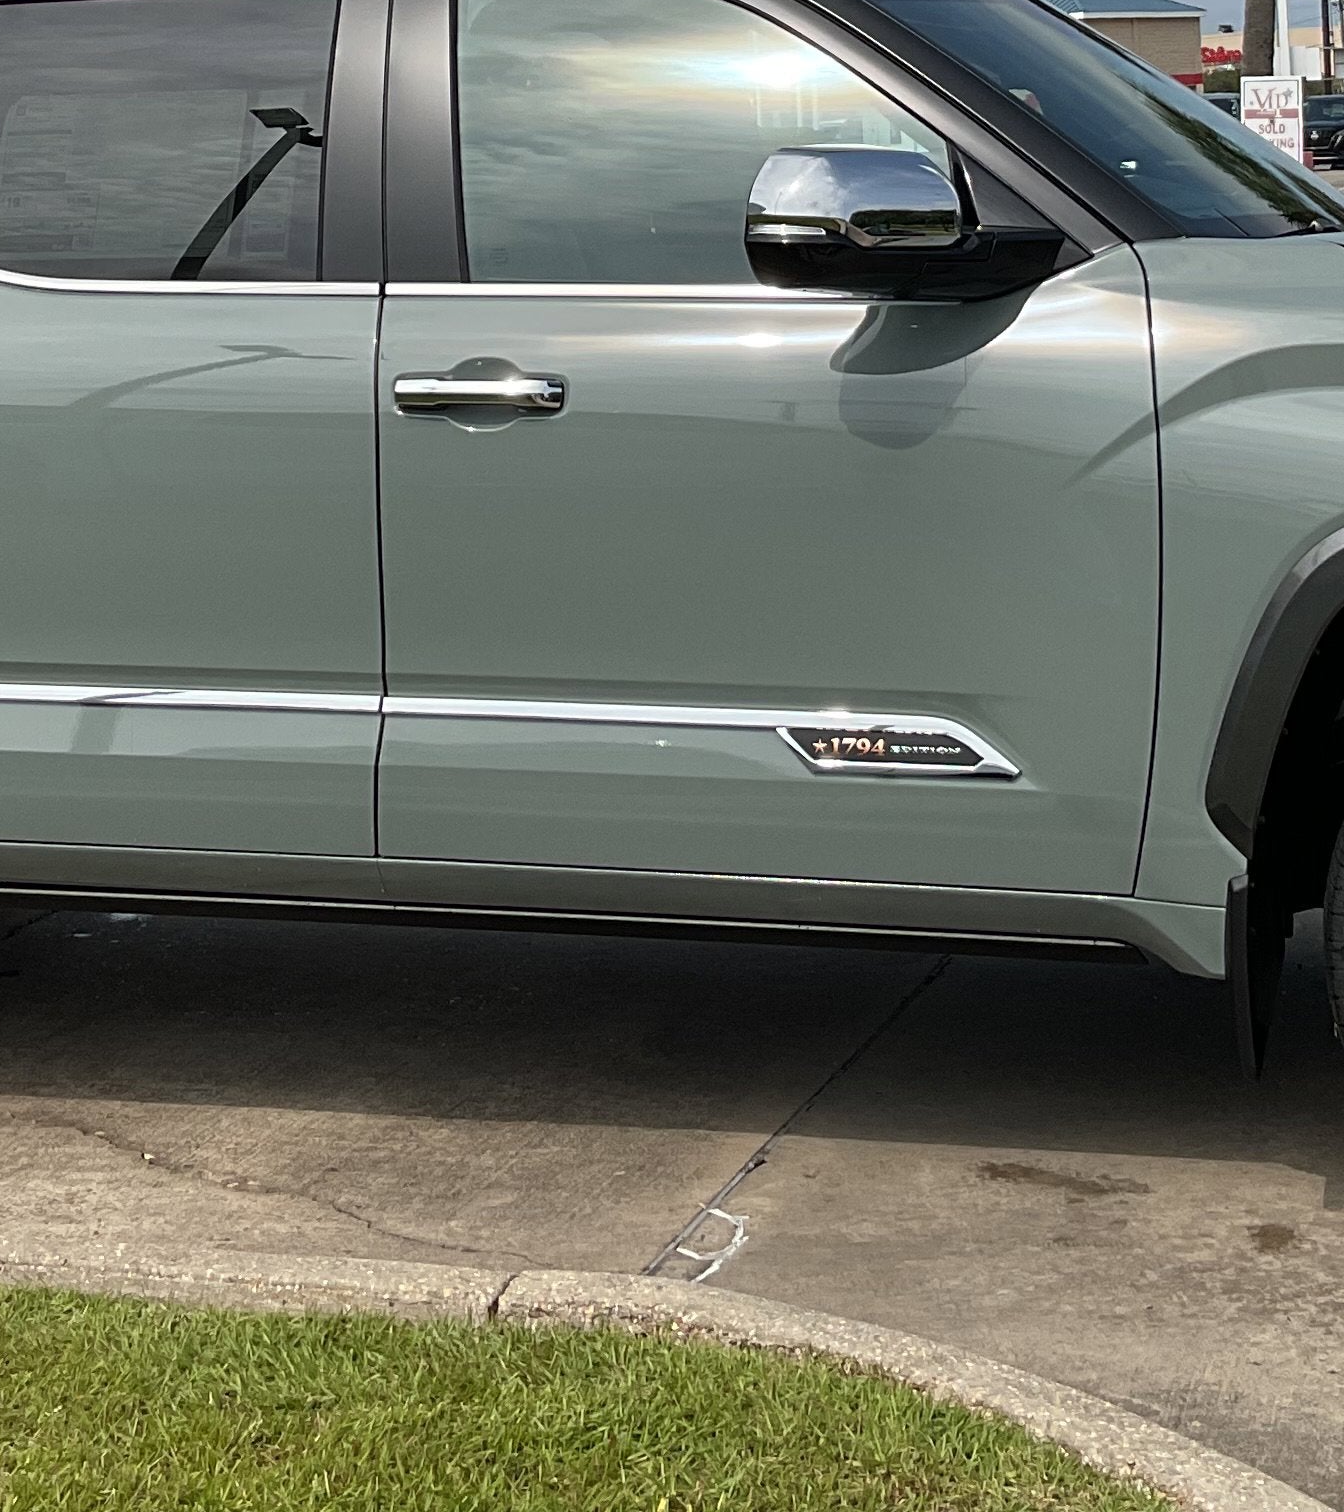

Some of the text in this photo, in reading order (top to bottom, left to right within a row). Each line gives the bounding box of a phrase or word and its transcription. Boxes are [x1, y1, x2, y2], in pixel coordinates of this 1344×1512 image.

[1258, 123, 1286, 135] SOLD
[830, 737, 962, 756] 1794 EDITION
